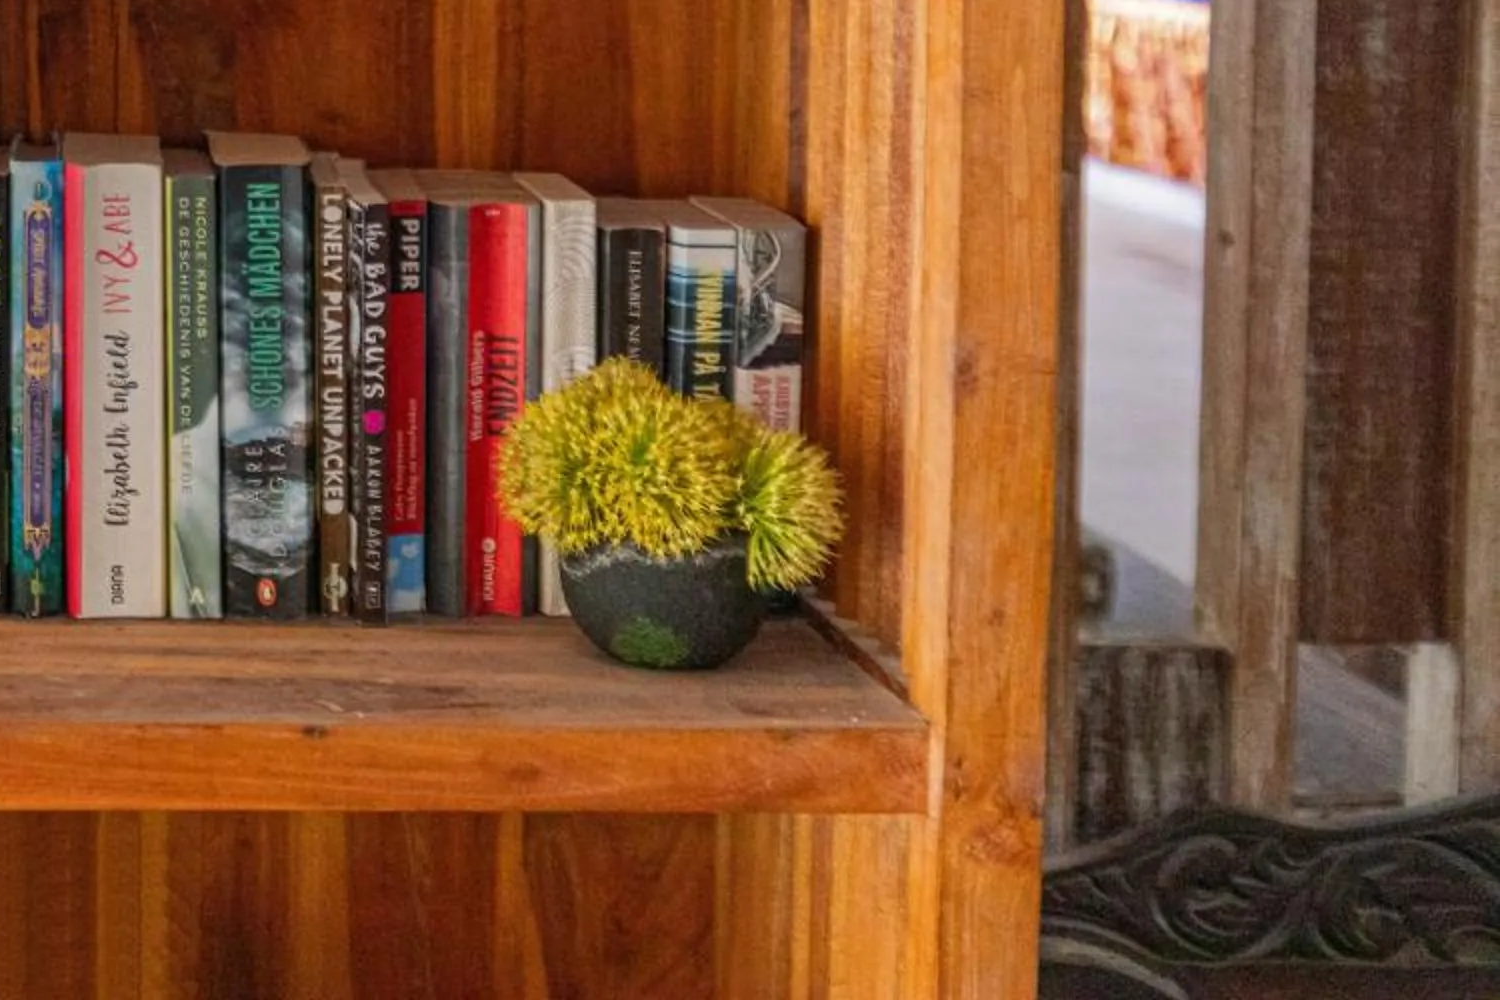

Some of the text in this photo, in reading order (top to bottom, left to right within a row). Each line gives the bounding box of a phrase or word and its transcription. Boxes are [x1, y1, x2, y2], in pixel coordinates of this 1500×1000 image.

[177, 196, 193, 215] DE
[95, 240, 140, 270] &
[195, 196, 209, 340] NICOLE KRAUSS
[400, 218, 421, 291] PIPER
[627, 249, 643, 319] ELISABET
[102, 275, 132, 314] IVY
[177, 220, 193, 360] GESCHIEDENIS
[242, 182, 286, 412] SCHÖNES MÄDCHEN
[363, 222, 386, 399] the BAD GUYS
[177, 364, 193, 401] VAN
[321, 192, 343, 516] LONELY PLANET UNPACKED
[693, 351, 726, 377] PÅ
[177, 403, 193, 427] DE
